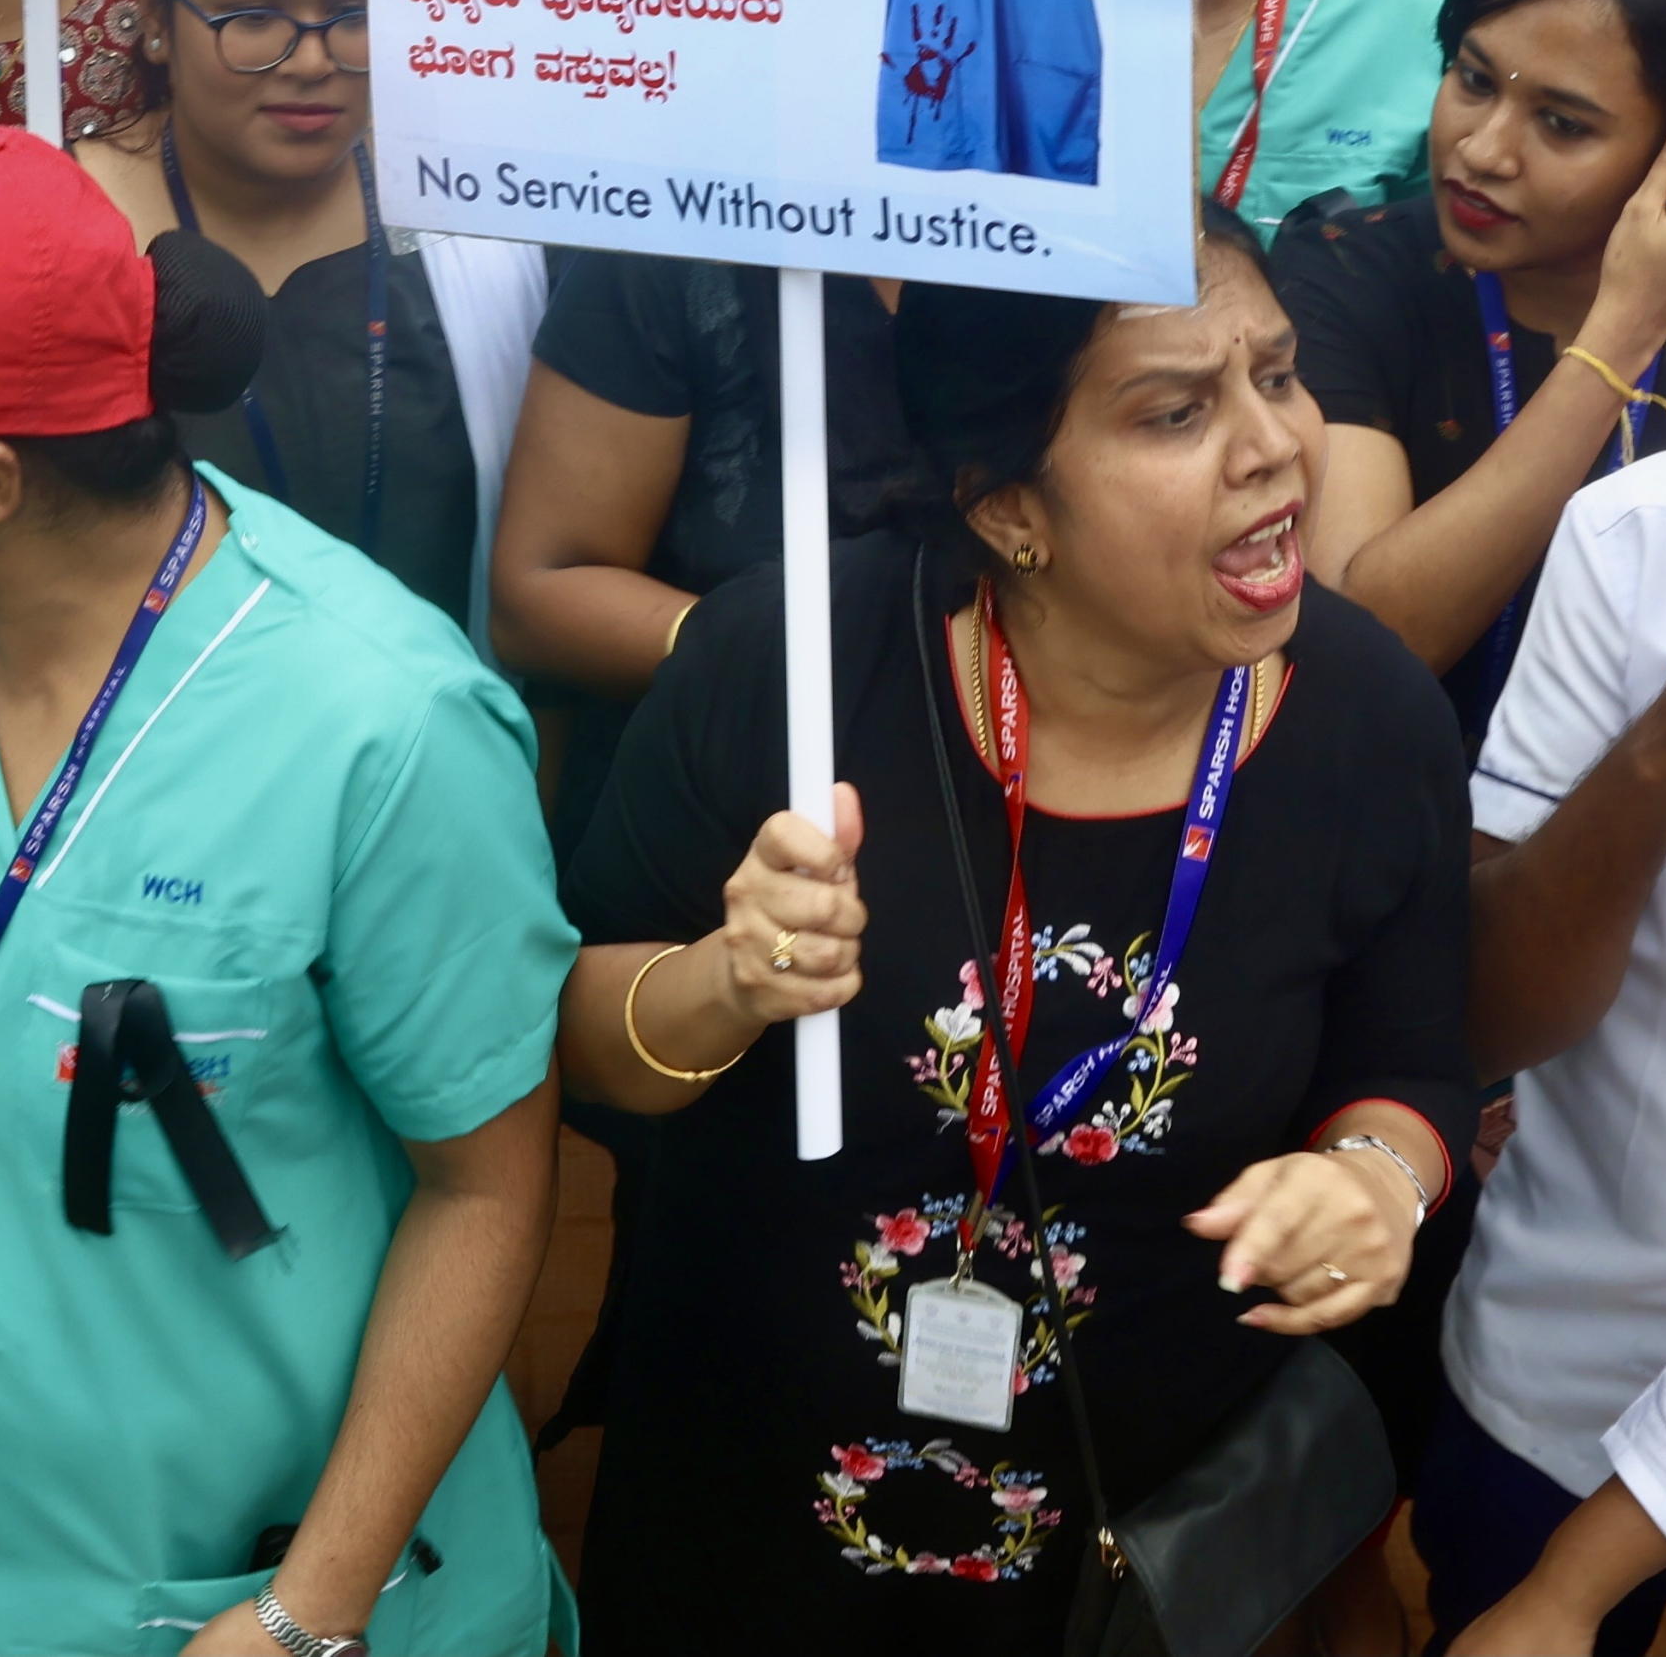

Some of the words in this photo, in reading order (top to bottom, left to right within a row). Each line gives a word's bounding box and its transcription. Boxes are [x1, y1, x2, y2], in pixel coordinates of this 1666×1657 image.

[418, 156, 480, 202] No
[497, 163, 651, 218] Service
[667, 178, 854, 236] Without
[873, 197, 1051, 256] Justice.
[1000, 658, 1018, 761] SPARSH
[25, 763, 80, 855] SPARSH
[1197, 709, 1236, 820] SPARSH
[142, 872, 204, 905] WCH
[1033, 1052, 1096, 1130] SPARSH
